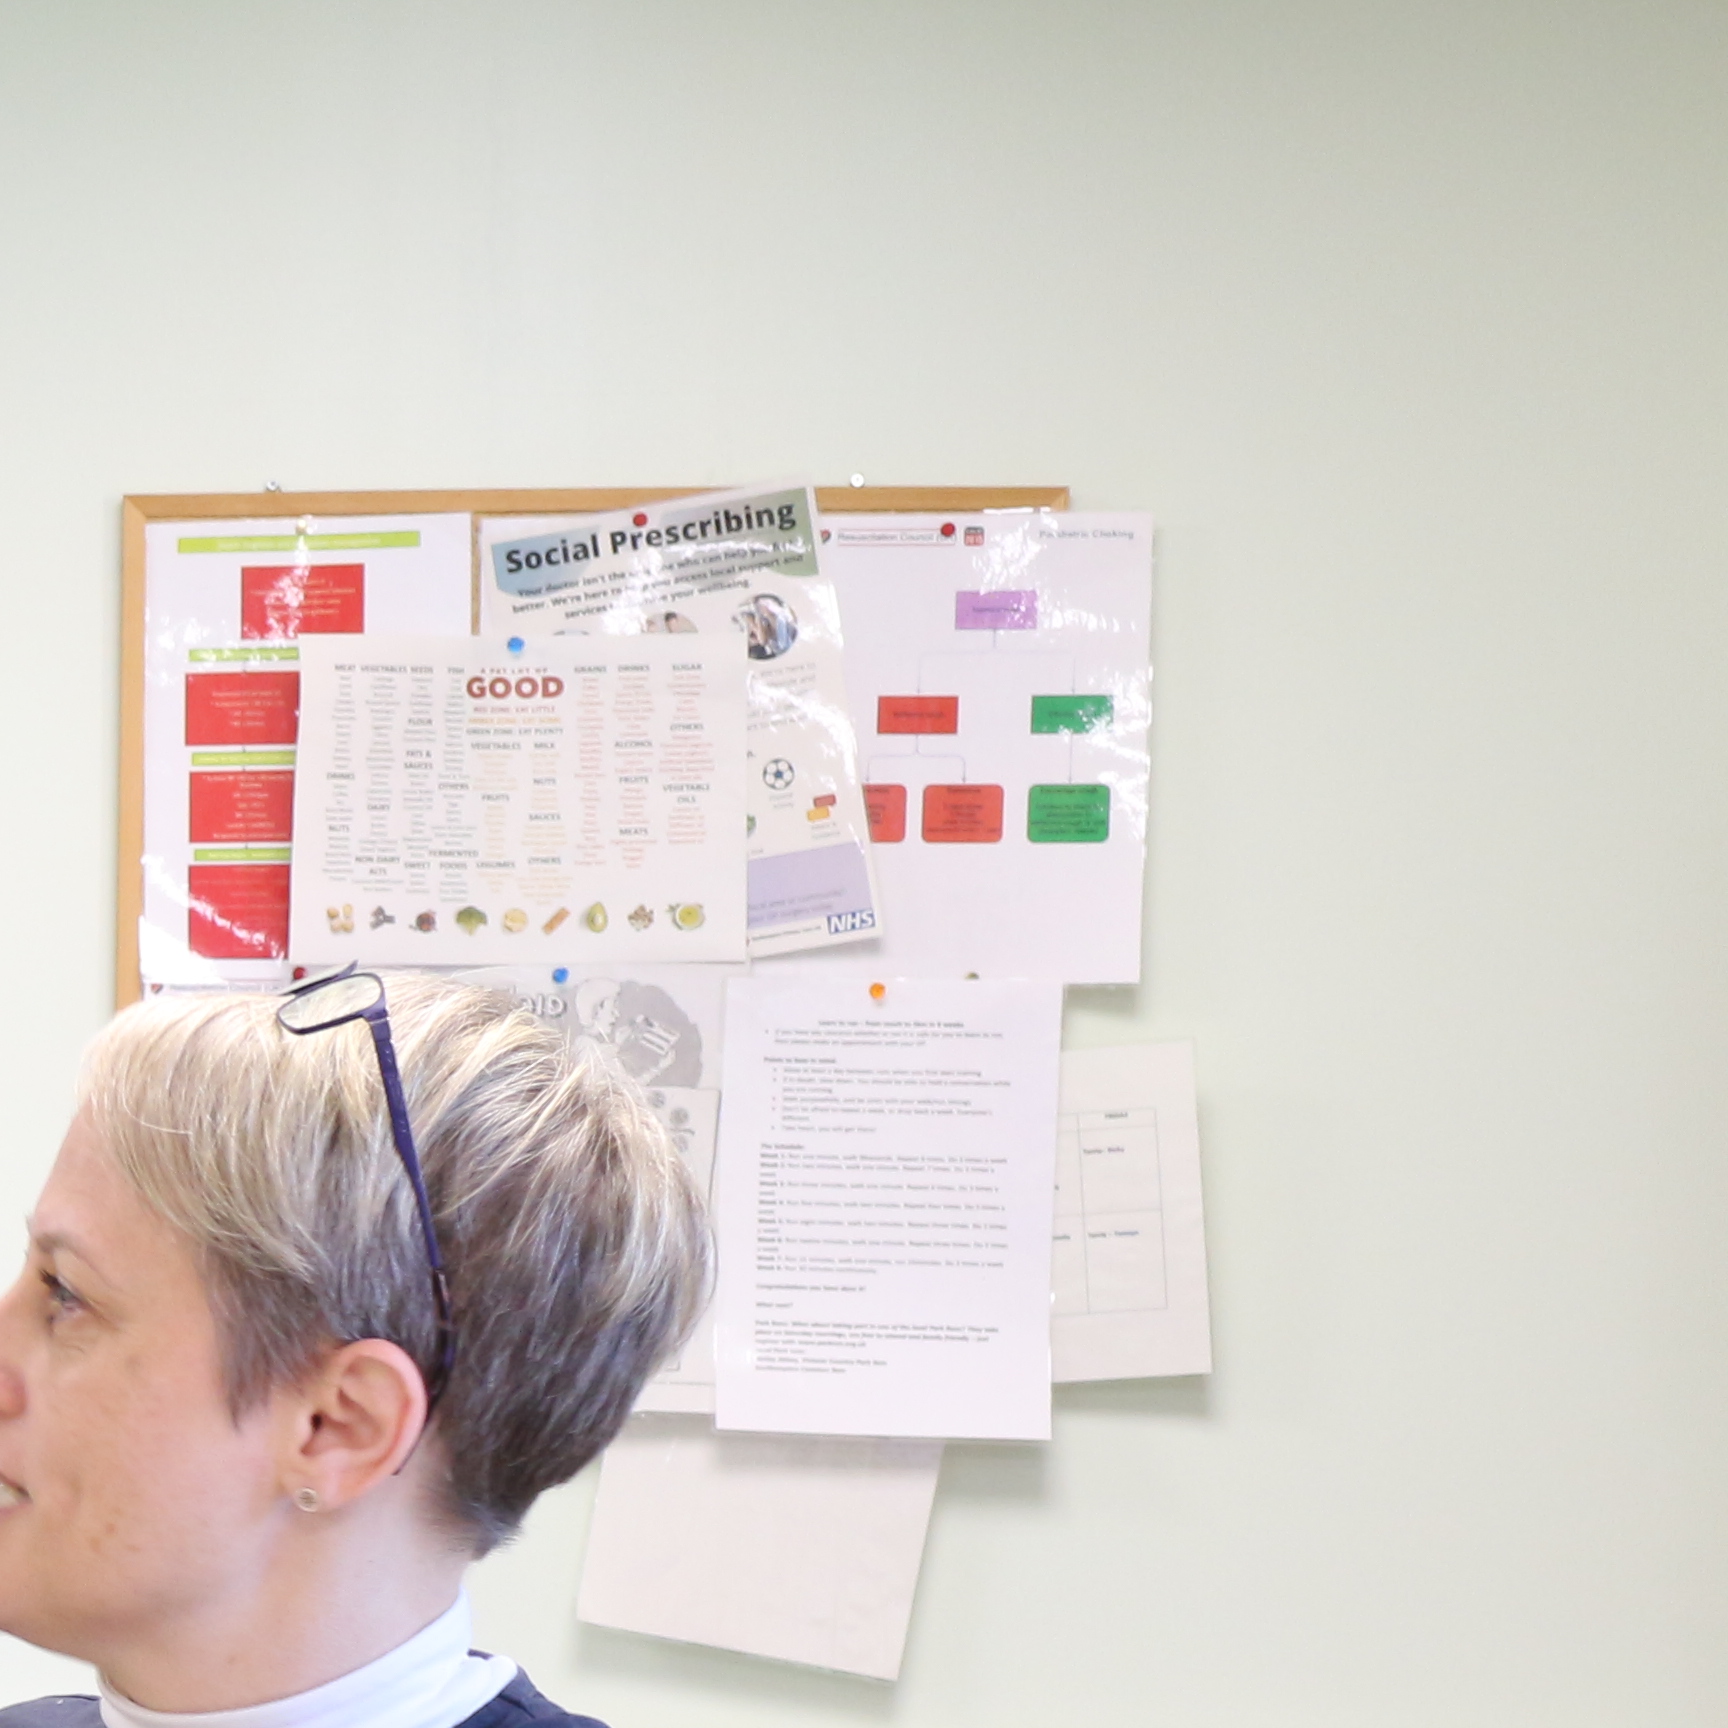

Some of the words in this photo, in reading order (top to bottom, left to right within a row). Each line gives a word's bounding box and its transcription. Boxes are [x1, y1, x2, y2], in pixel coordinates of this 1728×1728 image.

[506, 534, 600, 573] Social
[610, 503, 796, 555] Prescribing
[466, 676, 564, 699] GOOD
[830, 913, 874, 934] NHS
